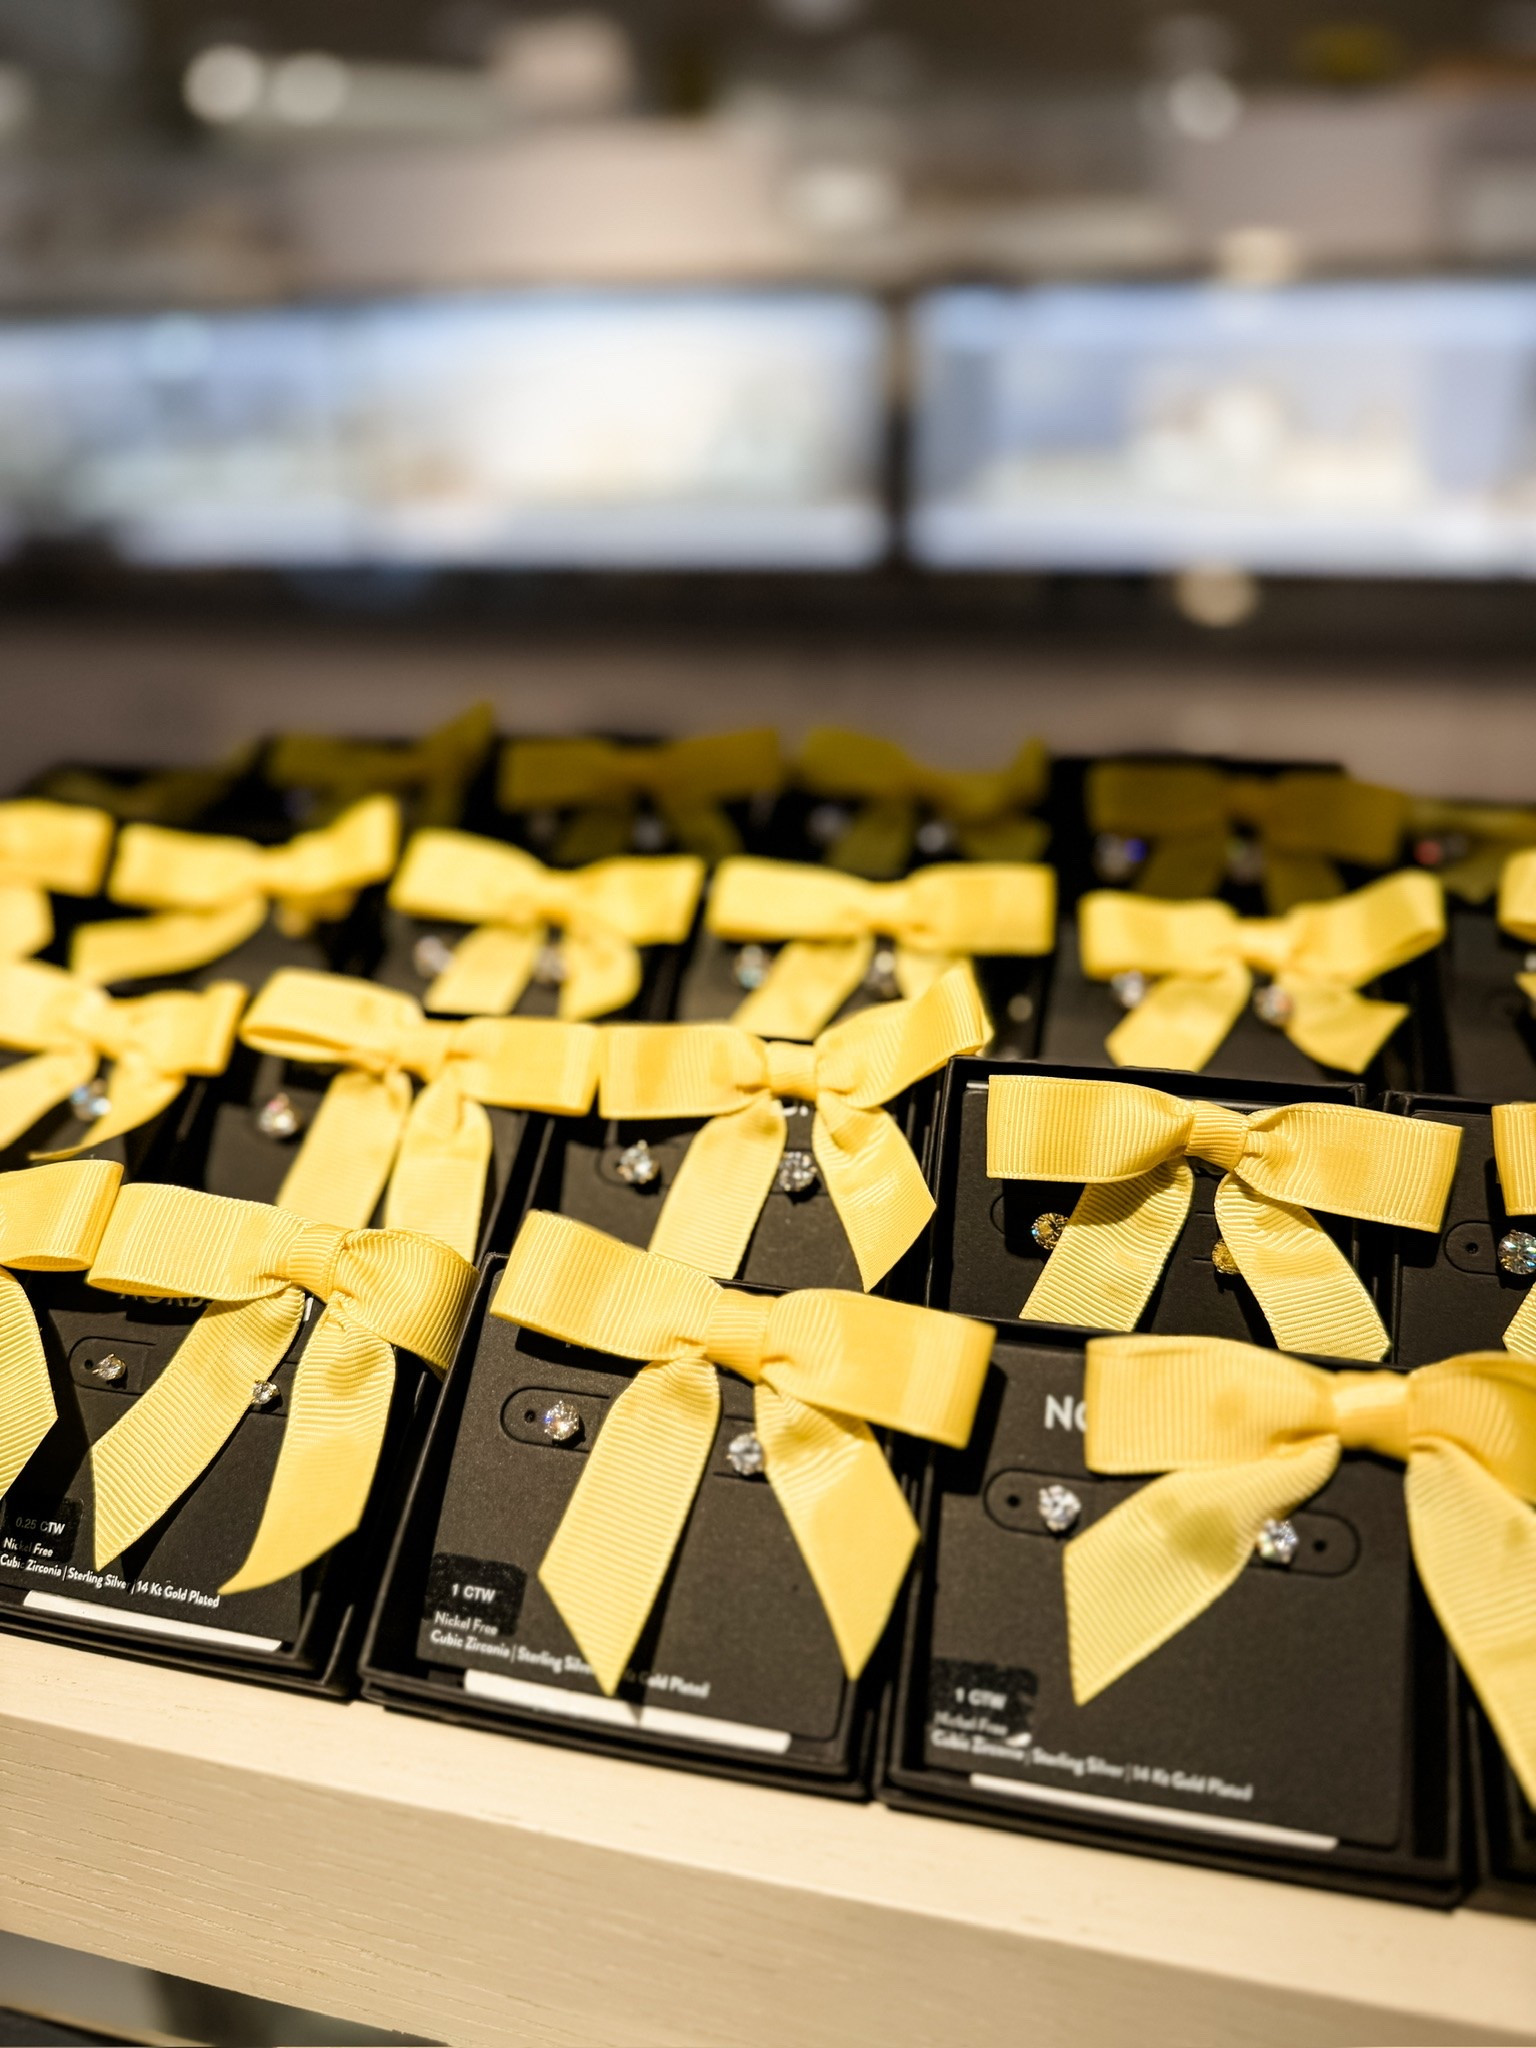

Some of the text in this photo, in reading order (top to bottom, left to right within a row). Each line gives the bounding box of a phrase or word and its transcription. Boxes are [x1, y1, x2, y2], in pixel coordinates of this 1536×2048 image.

[15, 1516, 66, 1535] 0.25 CTW
[3, 1537, 54, 1558] Nickel Free
[0, 1553, 221, 1610] Cubic Zirconia Sterling Silver 14 Kt Gold Plated
[451, 1583, 496, 1604] 1 CTW
[434, 1611, 499, 1637] Nickel Free
[430, 1629, 463, 1648] Cubic
[464, 1635, 511, 1659] Zirconia
[517, 1645, 563, 1674] Sterling
